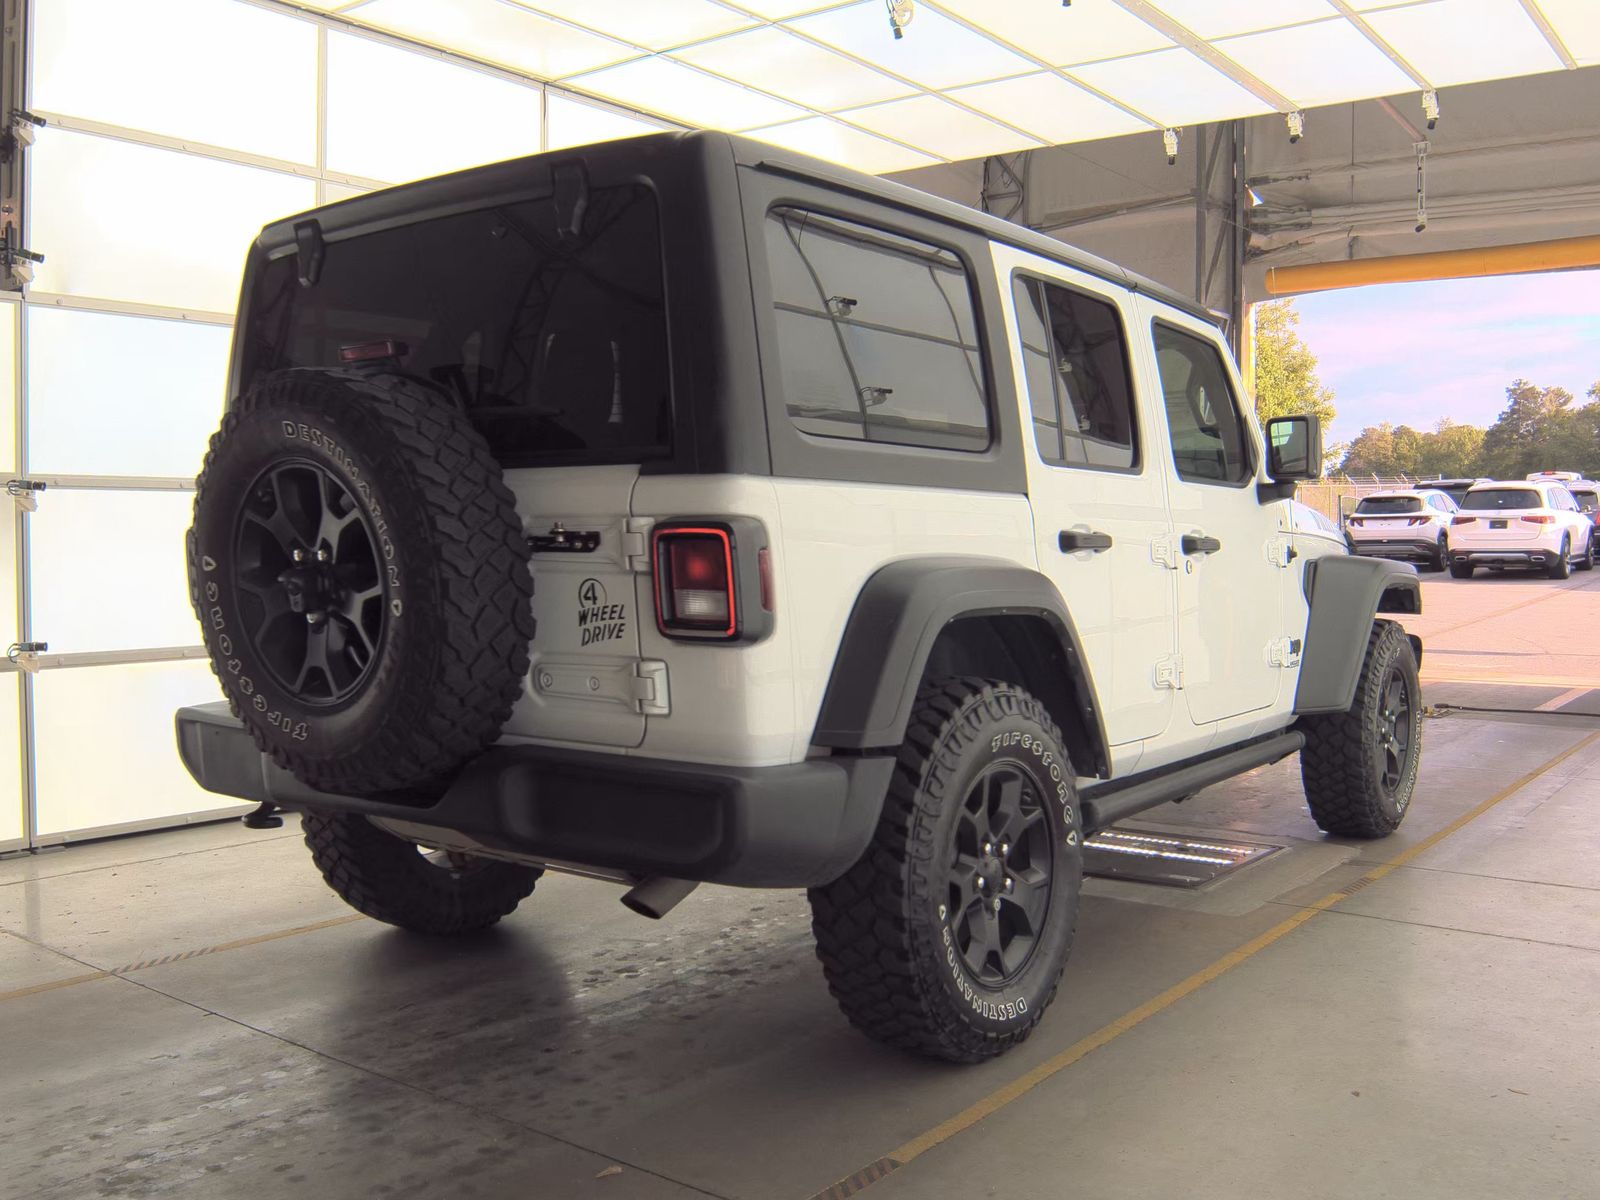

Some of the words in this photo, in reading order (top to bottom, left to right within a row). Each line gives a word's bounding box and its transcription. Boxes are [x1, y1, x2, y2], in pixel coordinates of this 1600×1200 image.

[282, 420, 400, 587] DESTINATION
[578, 604, 626, 627] WHEEL
[581, 623, 626, 647] DRIVE
[943, 926, 1027, 1021] DESTINATION
